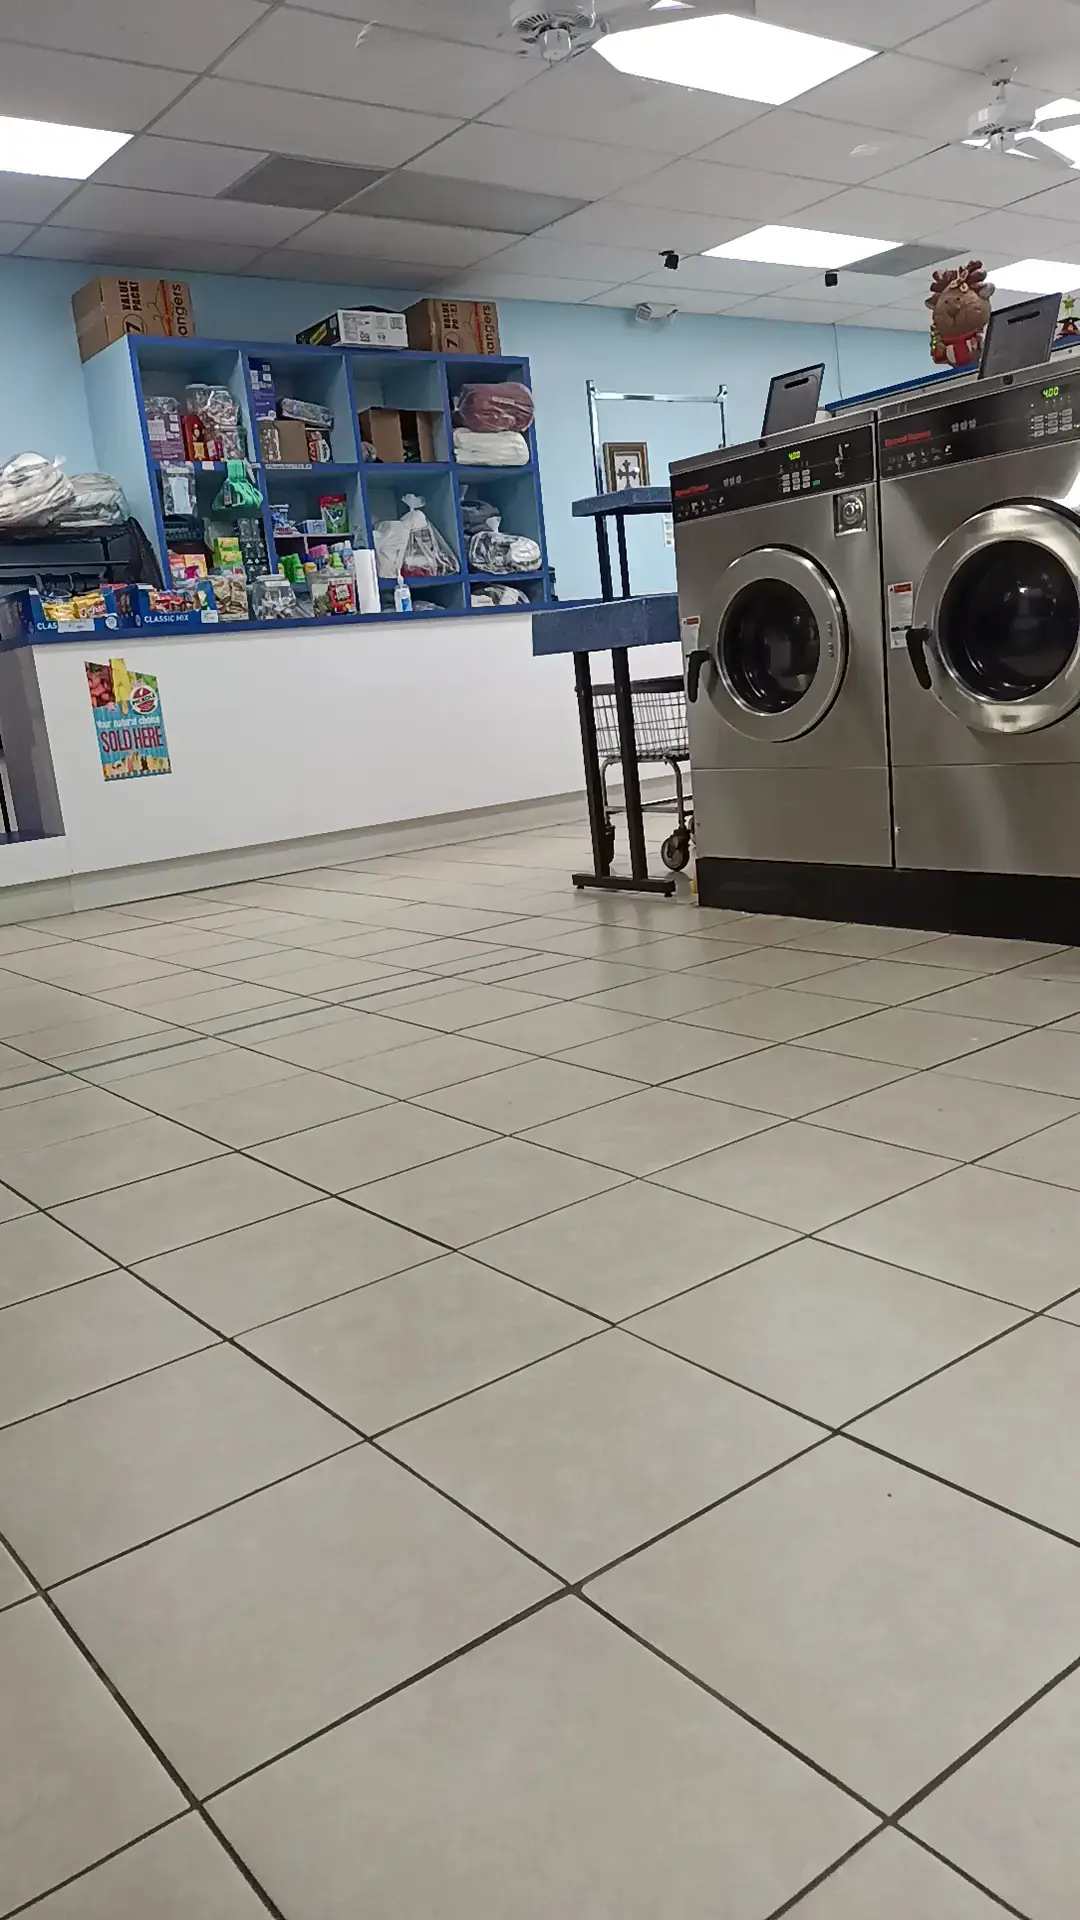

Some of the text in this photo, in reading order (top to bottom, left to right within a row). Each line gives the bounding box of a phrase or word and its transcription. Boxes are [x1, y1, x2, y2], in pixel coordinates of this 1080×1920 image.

[118, 279, 132, 311] VALUE
[172, 284, 188, 336] angers
[446, 338, 458, 349] 7
[36, 622, 58, 630] CLAS
[144, 614, 189, 623] CLASSIC MIX
[101, 726, 164, 753] SOLD HERE
